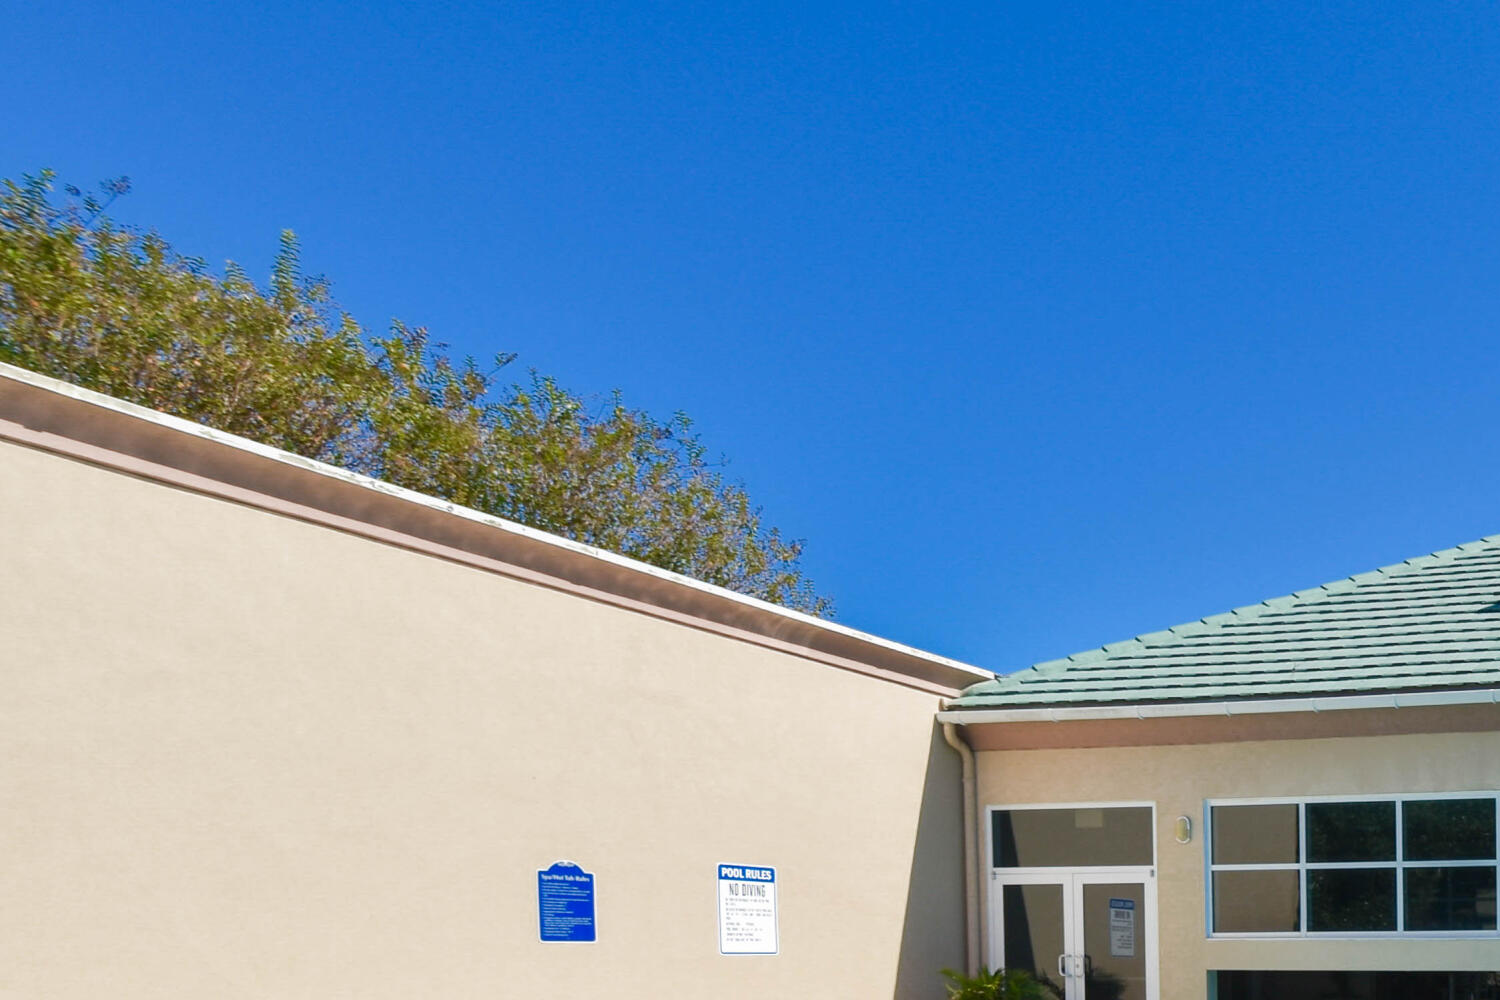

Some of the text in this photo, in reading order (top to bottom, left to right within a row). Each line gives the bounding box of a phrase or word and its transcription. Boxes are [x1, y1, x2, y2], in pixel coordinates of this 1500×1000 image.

[721, 868, 771, 880] POOL RULES
[729, 883, 766, 897] NO DIVING
